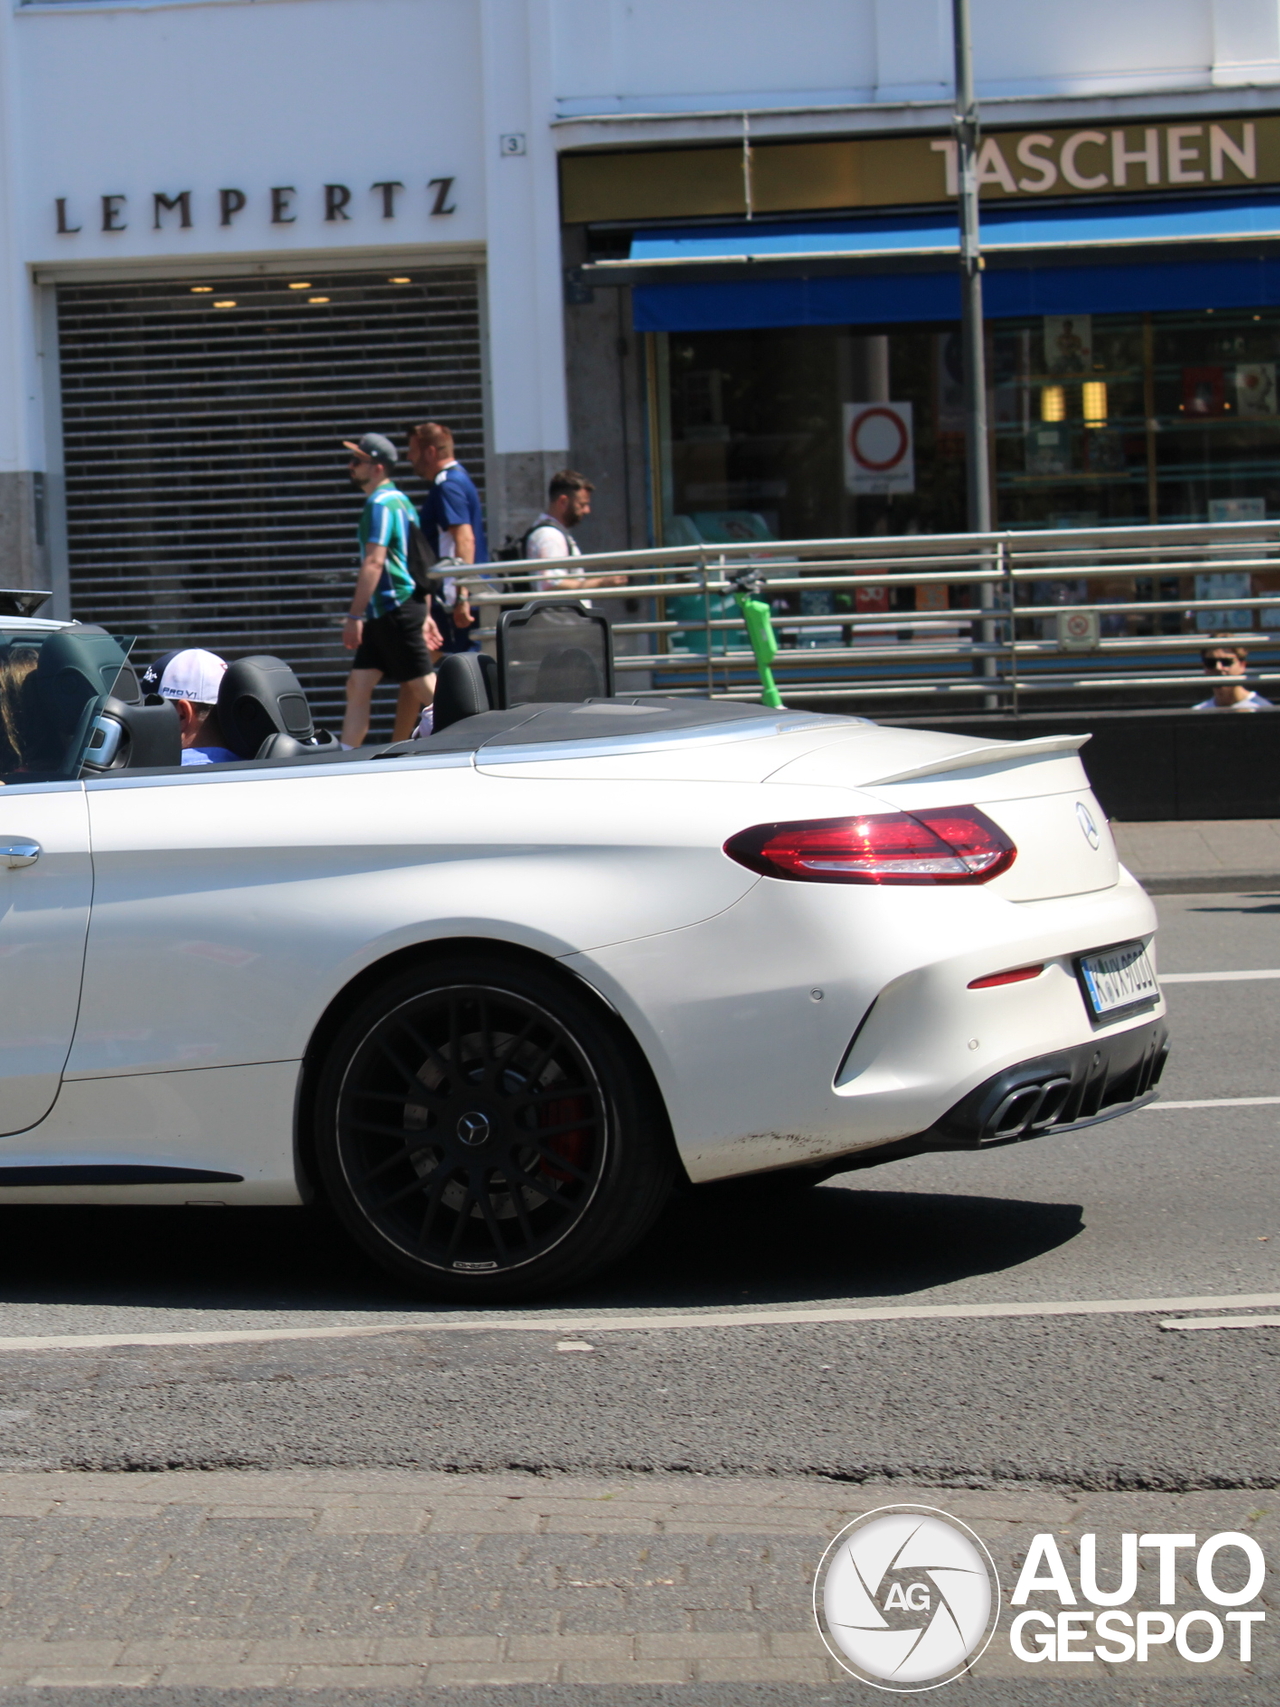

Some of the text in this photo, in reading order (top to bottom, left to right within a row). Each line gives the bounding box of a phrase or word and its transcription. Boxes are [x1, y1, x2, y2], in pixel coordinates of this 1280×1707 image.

[508, 138, 518, 152] 3
[930, 121, 1258, 197] TASCHEN
[55, 177, 458, 234] LEMPERTZ
[162, 686, 184, 697] PRO
[1089, 965, 1108, 1004] K
